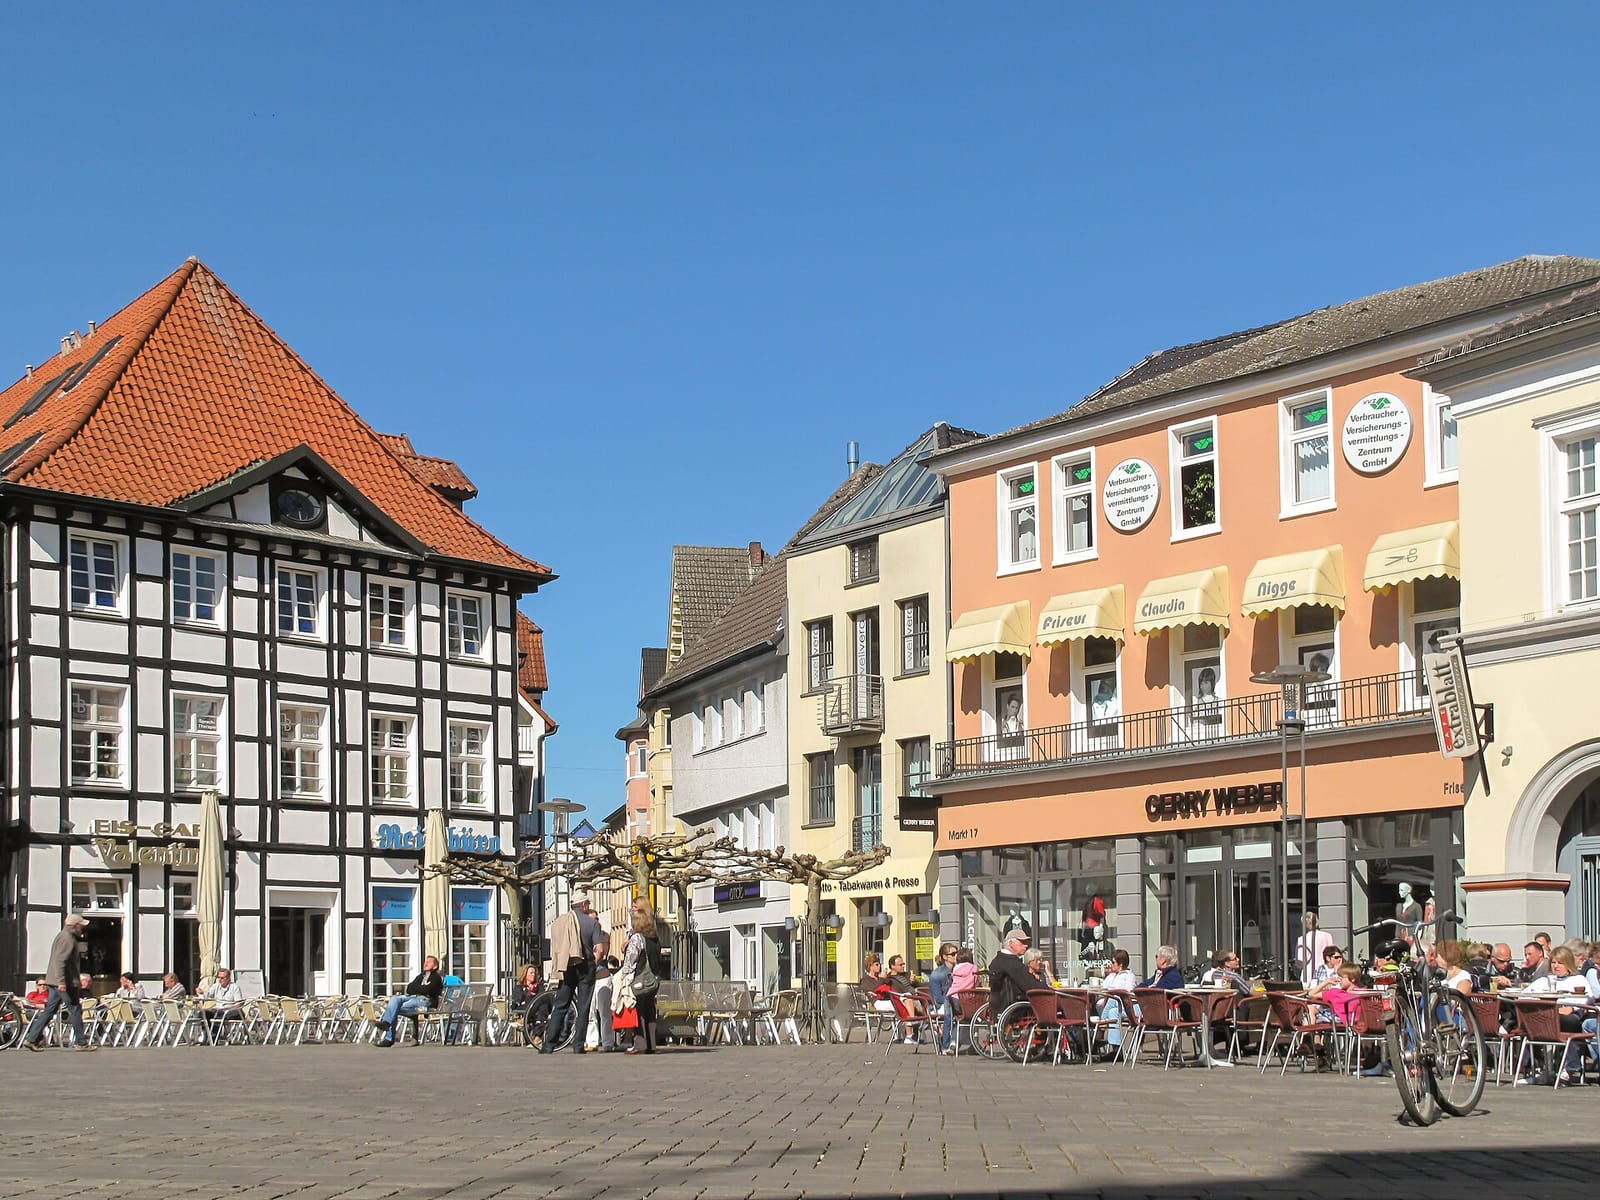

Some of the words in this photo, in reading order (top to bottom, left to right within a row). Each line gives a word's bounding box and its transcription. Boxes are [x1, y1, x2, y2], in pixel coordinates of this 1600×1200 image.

[1350, 410, 1398, 422] Verbraucher
[1346, 421, 1402, 434] Versicherungs
[1348, 433, 1399, 445] vermittlungs
[1358, 446, 1392, 456] Zentrum
[1362, 457, 1388, 468] GmbH
[1108, 474, 1147, 487] Verbraucher
[1105, 483, 1151, 498] Versicherungs
[1108, 494, 1149, 508] vermittlungs
[1116, 506, 1145, 517] Zentrum
[1120, 517, 1142, 526] GmbH
[1257, 578, 1297, 598] Nigge
[1141, 598, 1185, 617] Claudia
[1042, 613, 1087, 630] Friseur
[1432, 660, 1466, 749] extrablatt
[1443, 781, 1464, 795] Frise
[1144, 788, 1211, 820] GERRY
[1212, 782, 1284, 815] WEBER
[93, 819, 200, 837] EIS-CAF
[948, 830, 968, 840] Markt
[970, 828, 979, 838] 17
[375, 823, 501, 852] Reibüro
[92, 837, 200, 866] Valentin
[820, 882, 833, 892] tto
[839, 879, 883, 891] Tabakwaren
[885, 877, 891, 889] &
[893, 877, 920, 889] Presse
[967, 911, 975, 949] JACKE
